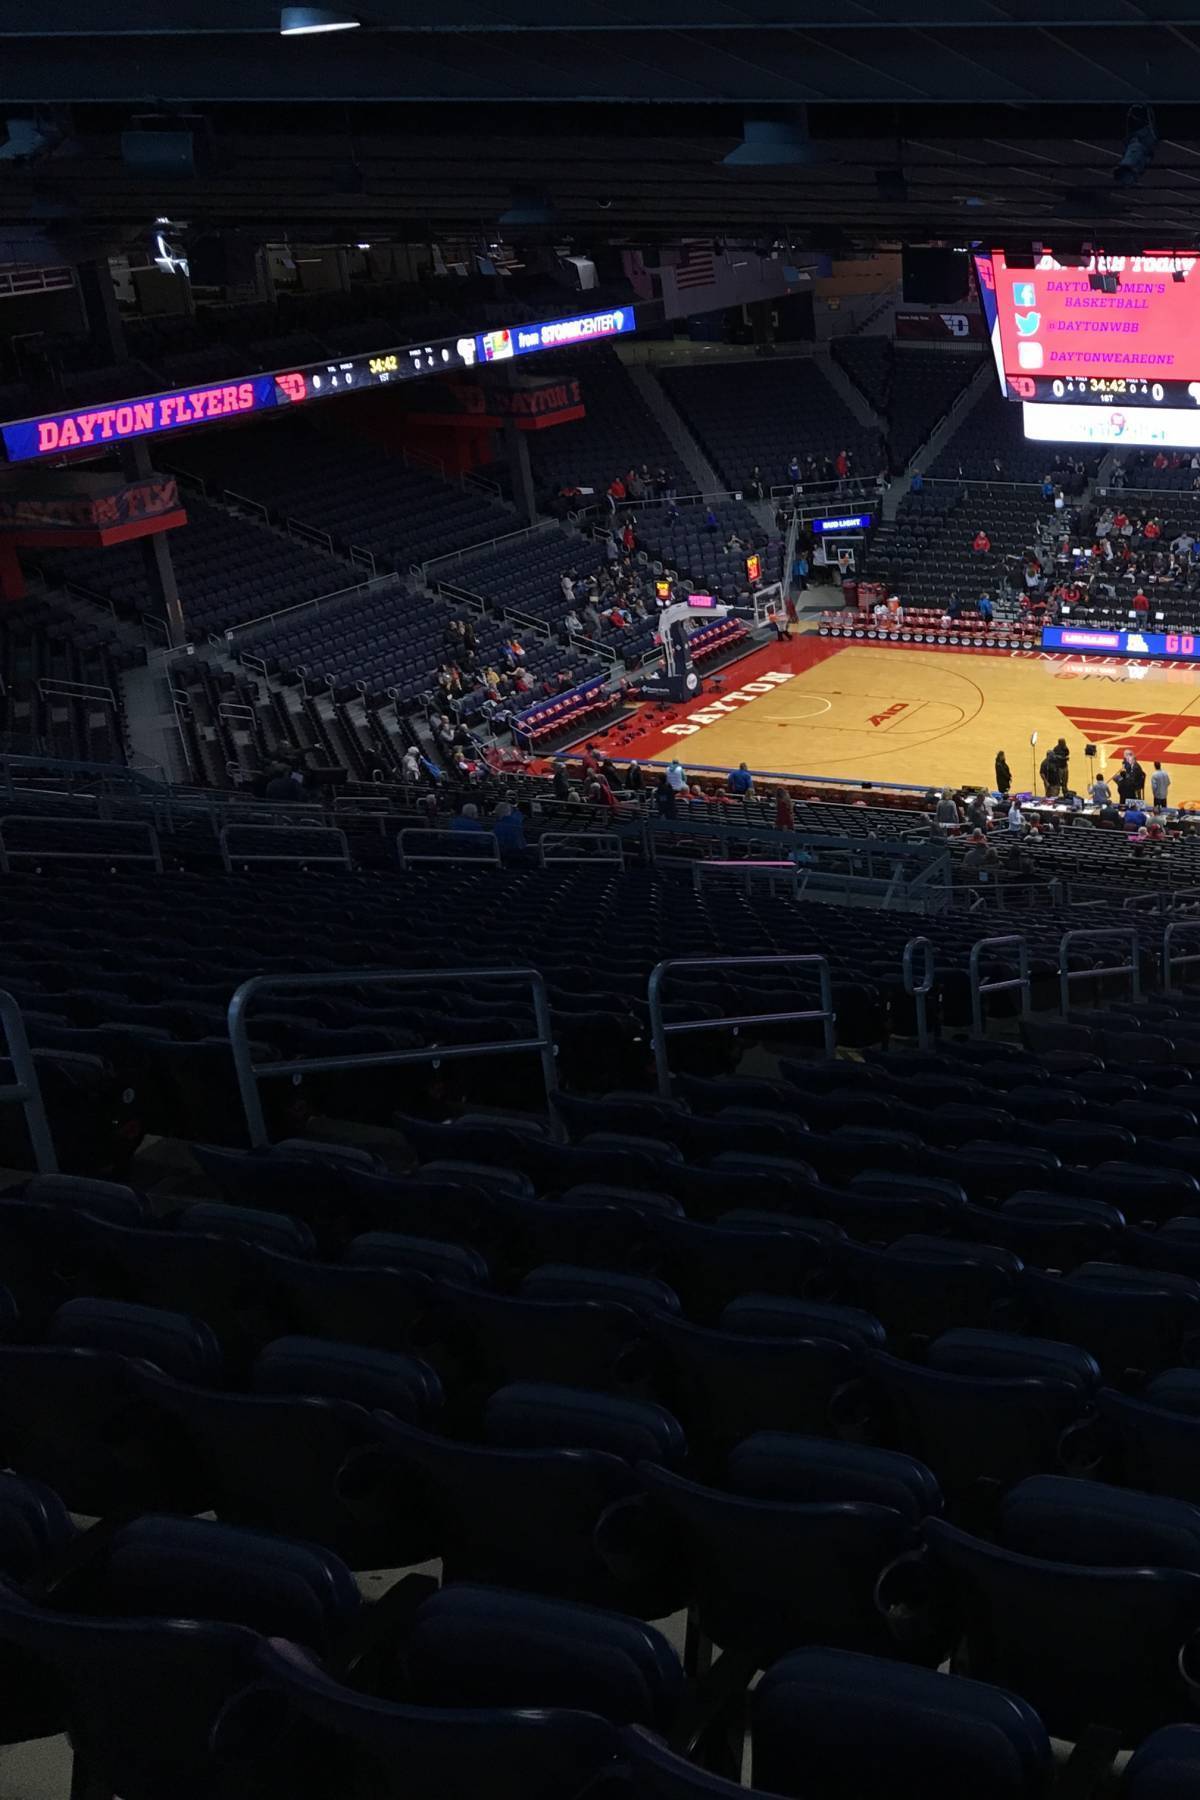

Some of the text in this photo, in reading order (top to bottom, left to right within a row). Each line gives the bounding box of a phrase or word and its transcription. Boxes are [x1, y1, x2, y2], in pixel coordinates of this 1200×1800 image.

[1047, 282, 1165, 294] DAYTO OMEN'S
[1065, 298, 1149, 309] BASKETBALL
[1050, 351, 1175, 365] DAYTONWEAREONE
[1052, 379, 1065, 397] 0
[1090, 378, 1126, 393] 34:42
[1151, 383, 1164, 401] 0
[38, 383, 254, 451] DAYTON FLYERS
[1166, 633, 1194, 654] GO
[661, 671, 796, 735] DAYTON
